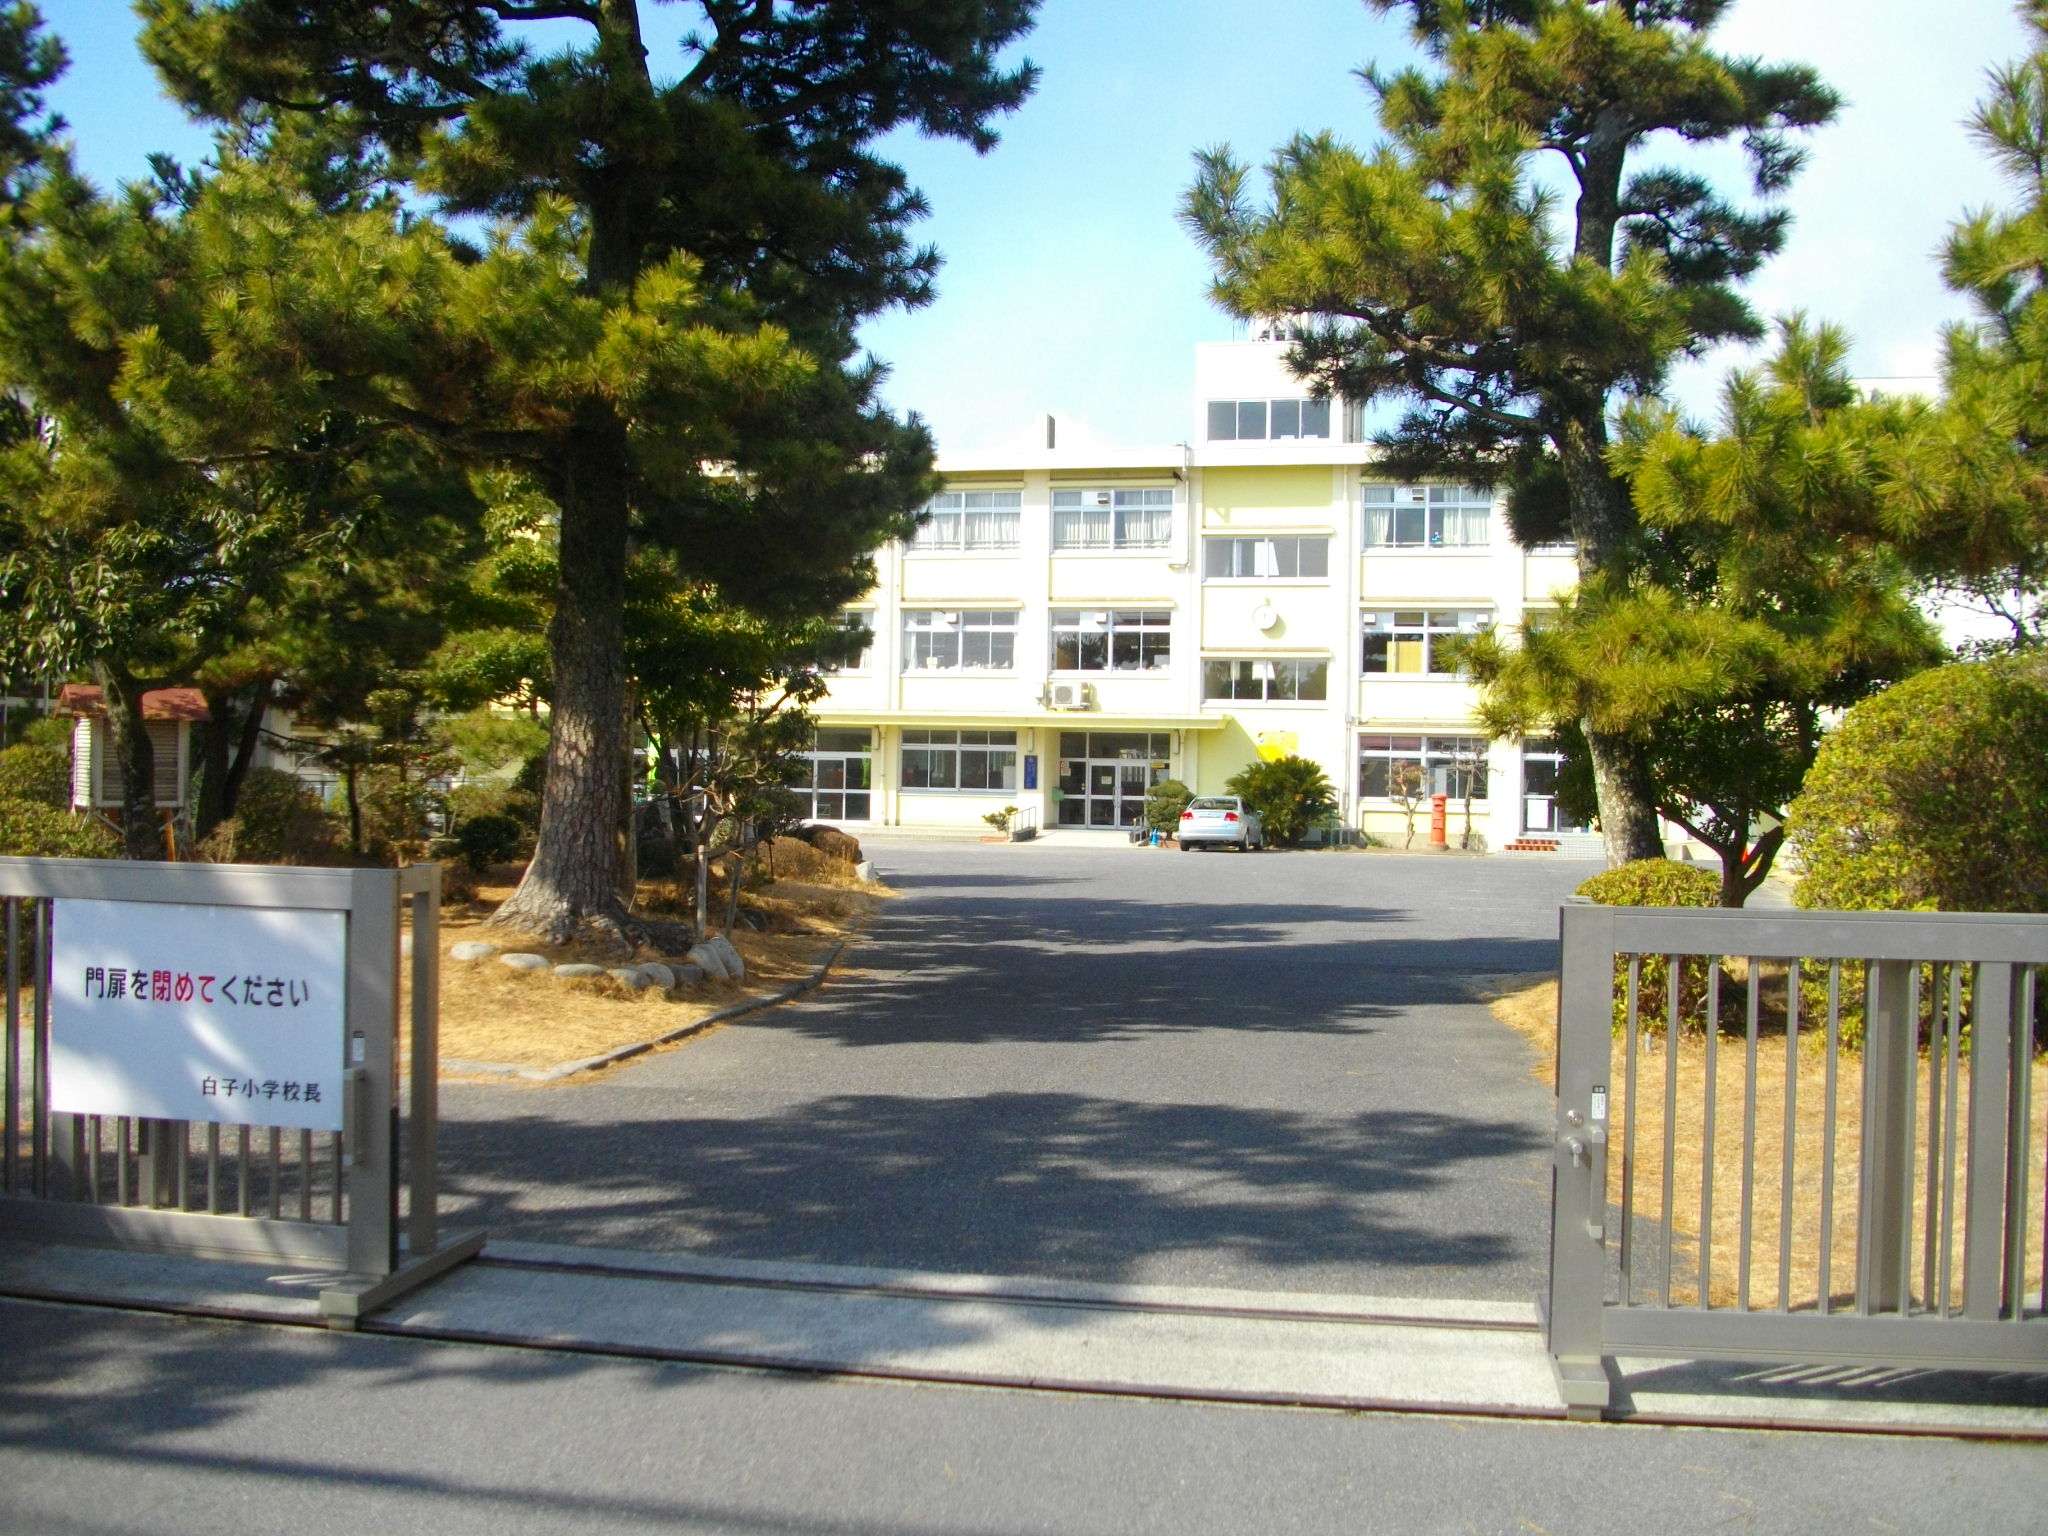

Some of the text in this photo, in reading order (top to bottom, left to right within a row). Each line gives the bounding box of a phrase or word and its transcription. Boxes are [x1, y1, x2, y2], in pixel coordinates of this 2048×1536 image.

[85, 966, 309, 1007] 門扉を閉めてください
[202, 1076, 322, 1103] 白子小学校長
